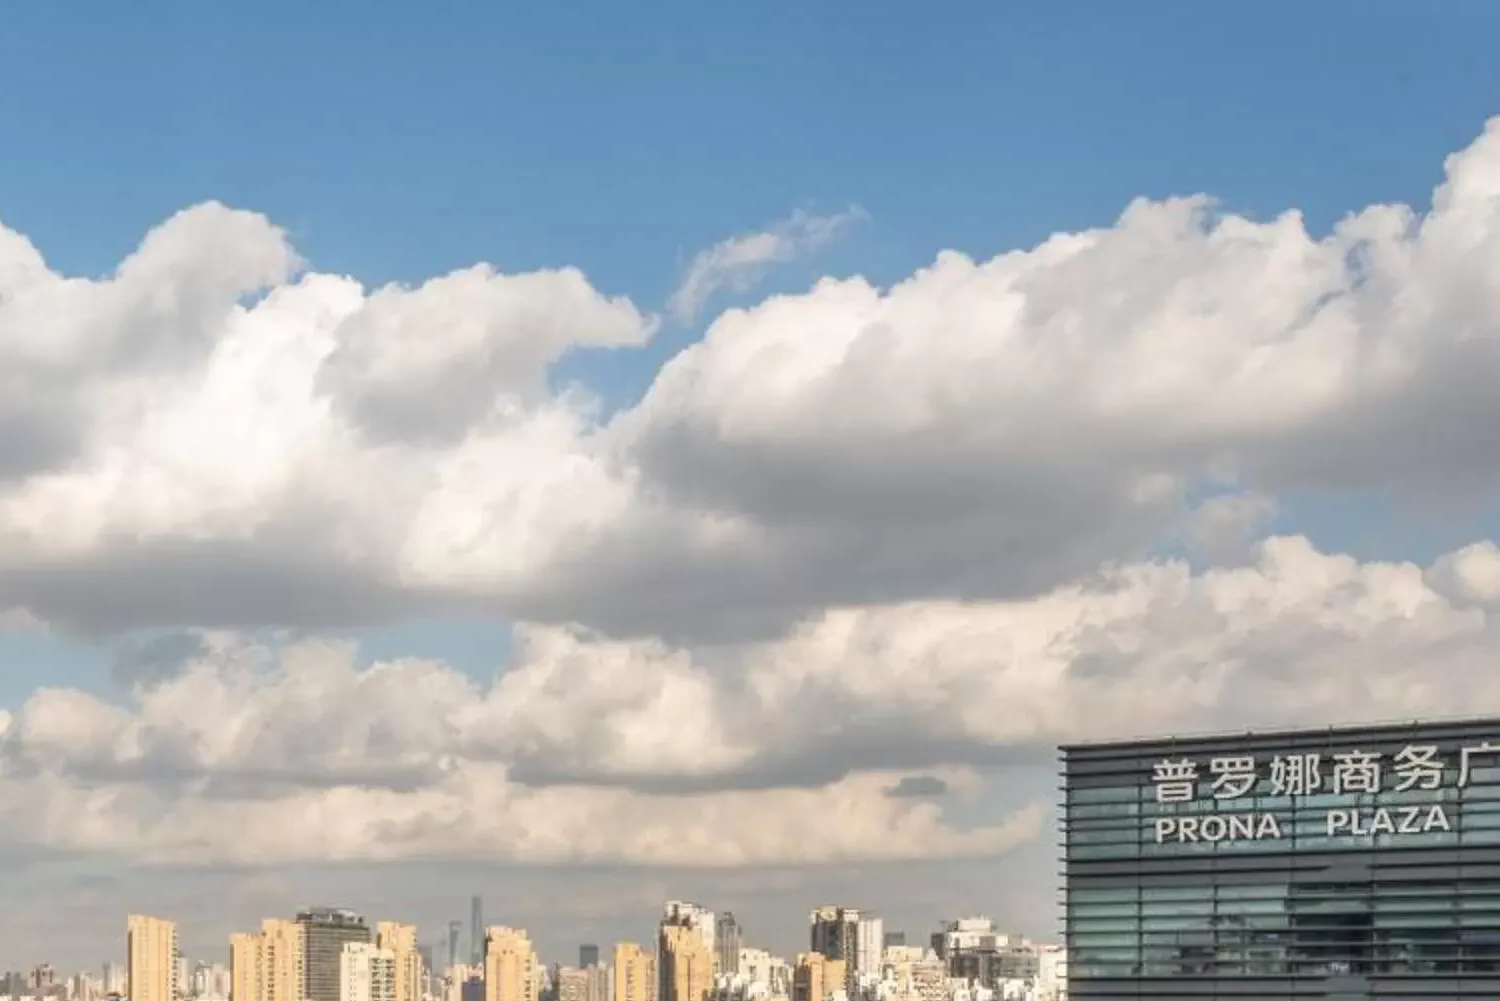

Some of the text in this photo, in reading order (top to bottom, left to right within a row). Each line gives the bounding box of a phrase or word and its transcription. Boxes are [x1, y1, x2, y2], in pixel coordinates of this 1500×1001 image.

[1151, 742, 1500, 804] 普罗娜商务广
[1155, 804, 1451, 844] PRONA PLAZA
